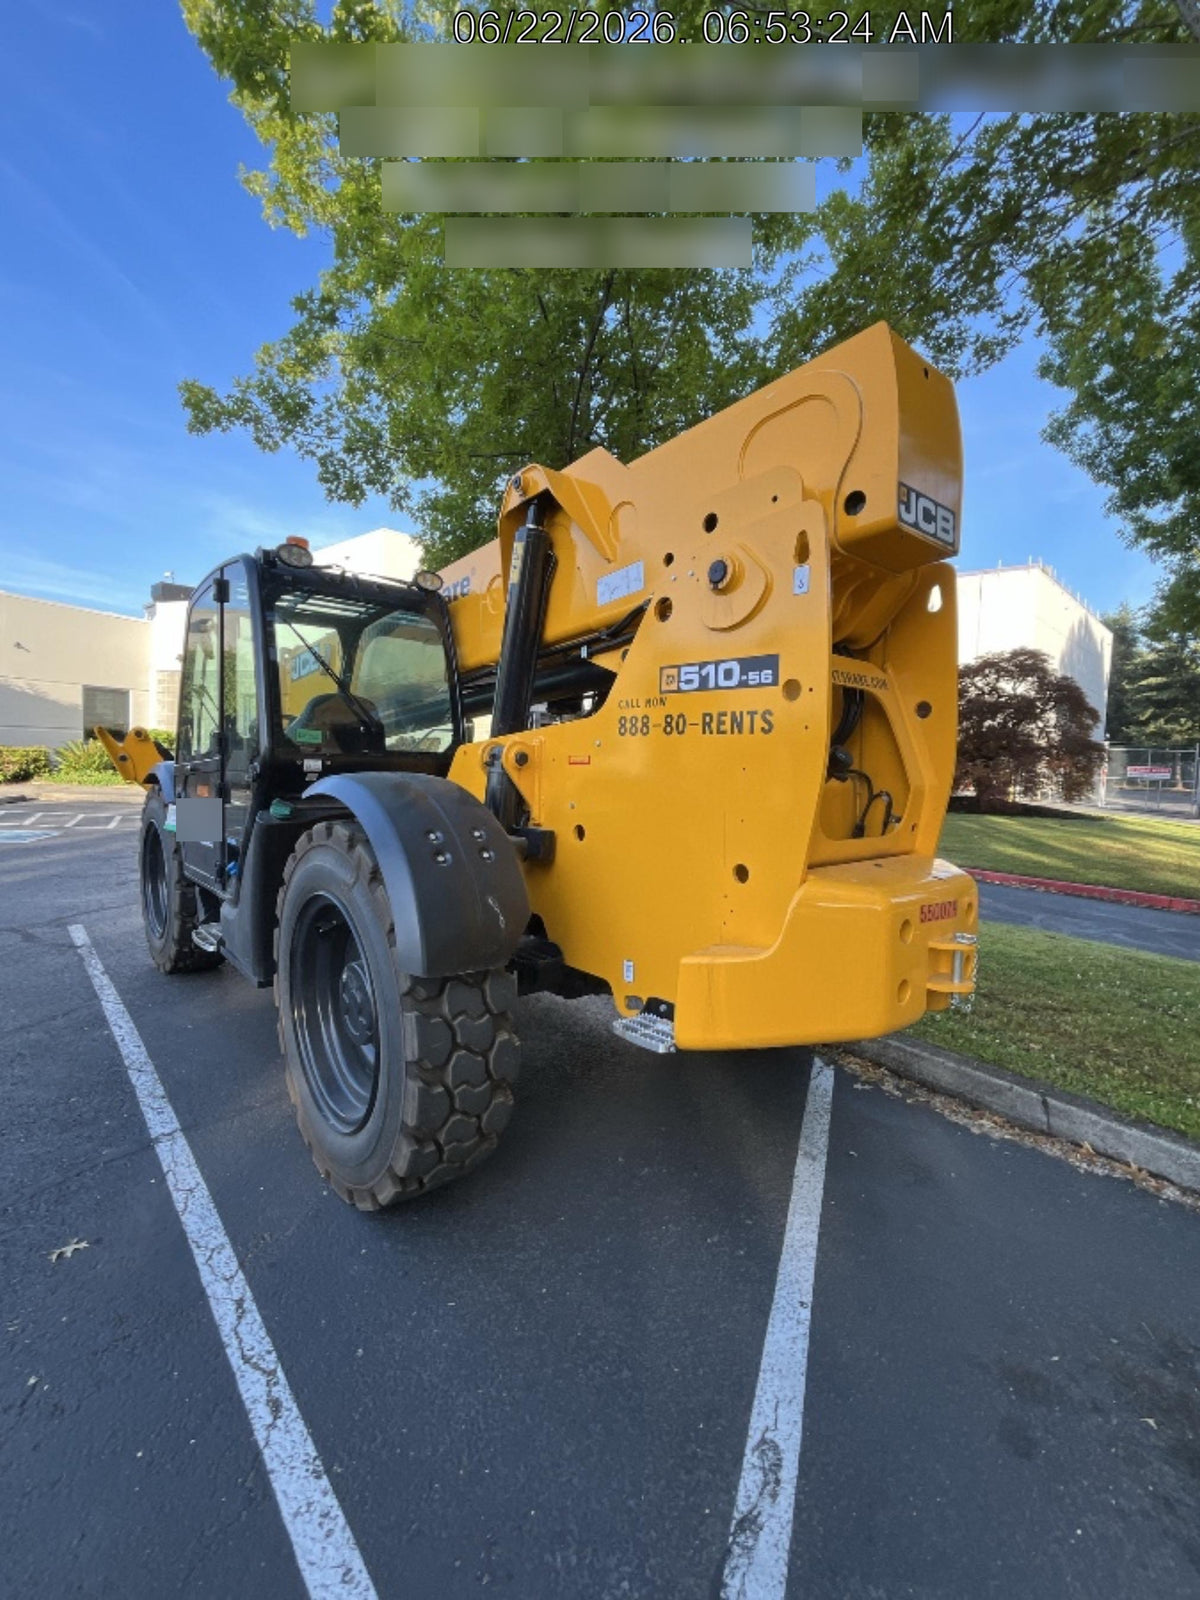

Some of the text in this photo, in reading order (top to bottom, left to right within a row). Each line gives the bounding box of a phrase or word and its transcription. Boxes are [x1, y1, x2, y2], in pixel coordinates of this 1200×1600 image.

[899, 490, 955, 544] JCB
[679, 660, 773, 691] 510-56
[618, 698, 641, 709] CALL
[618, 709, 774, 737] 888-80-RENTS
